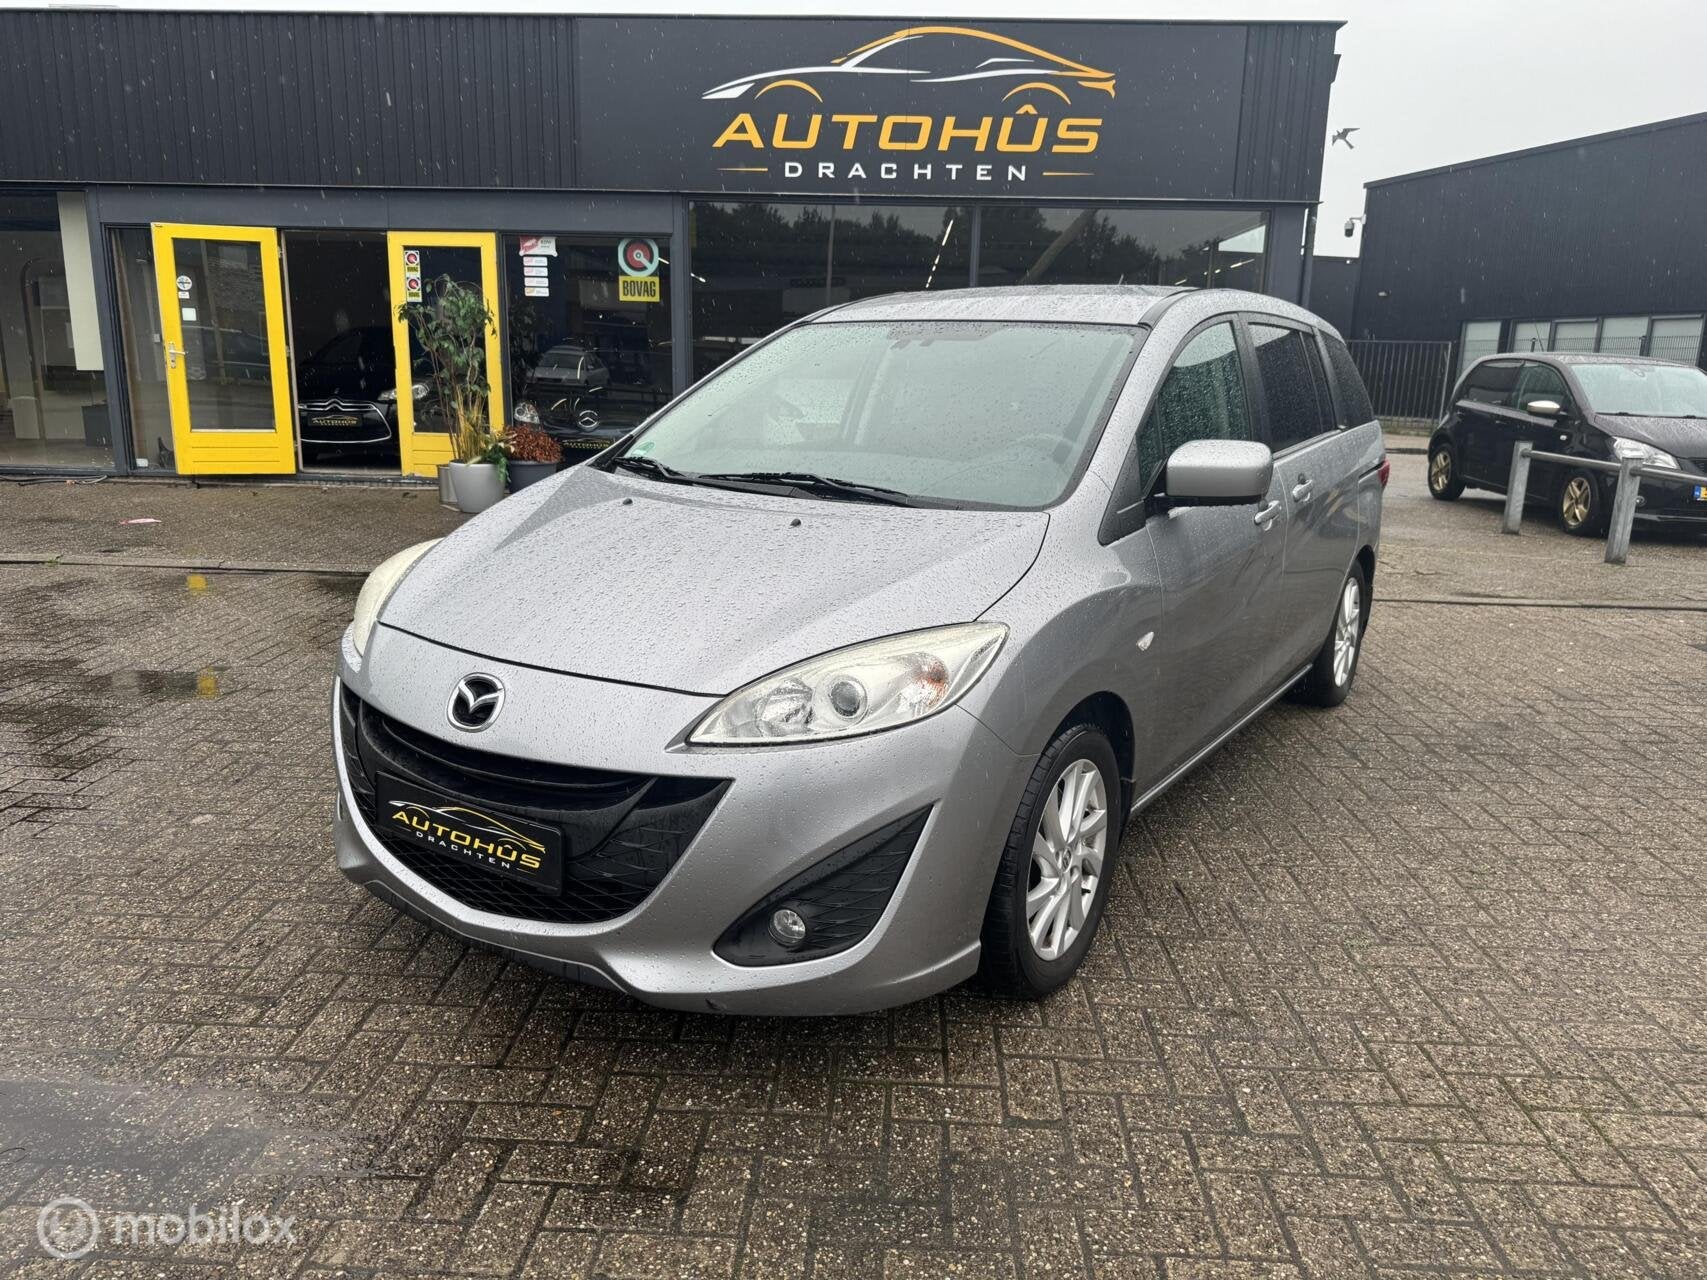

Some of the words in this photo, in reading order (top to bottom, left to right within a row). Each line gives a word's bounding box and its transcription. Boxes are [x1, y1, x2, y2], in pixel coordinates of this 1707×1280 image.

[712, 103, 1103, 154] AUTOHÛS
[784, 161, 1026, 181] DRACHTEN
[622, 280, 656, 298] BOVAG
[392, 811, 541, 870] AUTOHÛS
[415, 831, 511, 869] DRACHTEN
